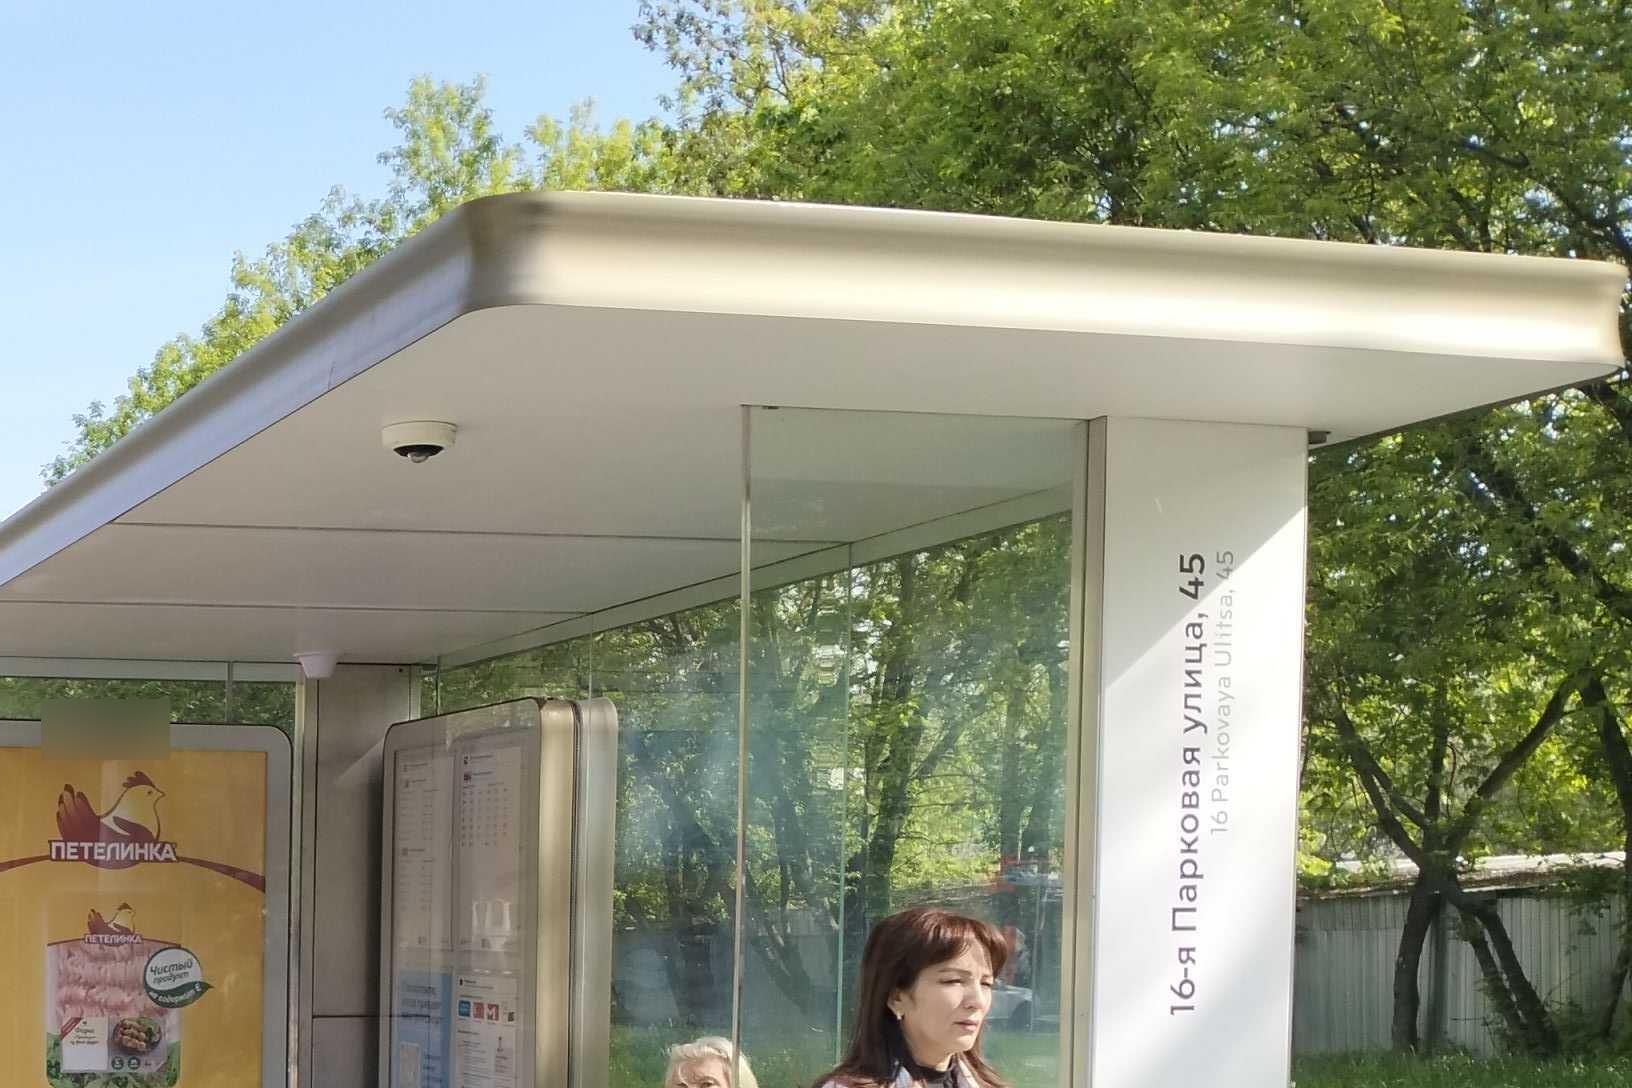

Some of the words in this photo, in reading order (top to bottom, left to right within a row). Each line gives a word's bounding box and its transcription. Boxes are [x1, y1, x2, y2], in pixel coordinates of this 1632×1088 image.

[1178, 553, 1206, 600] 45
[1215, 551, 1234, 580] 45
[1213, 589, 1237, 667] Ulitsa,
[1182, 612, 1209, 735] улица,
[1210, 676, 1235, 802] Parkovaya
[1171, 747, 1204, 932] Парковая
[1210, 810, 1229, 836] 16
[50, 841, 178, 861] ПЕТЕЛИНКА
[83, 933, 143, 945] ПЕТЕЛИНКА
[150, 958, 193, 976] Чистый
[1170, 946, 1196, 1016] 16-я
